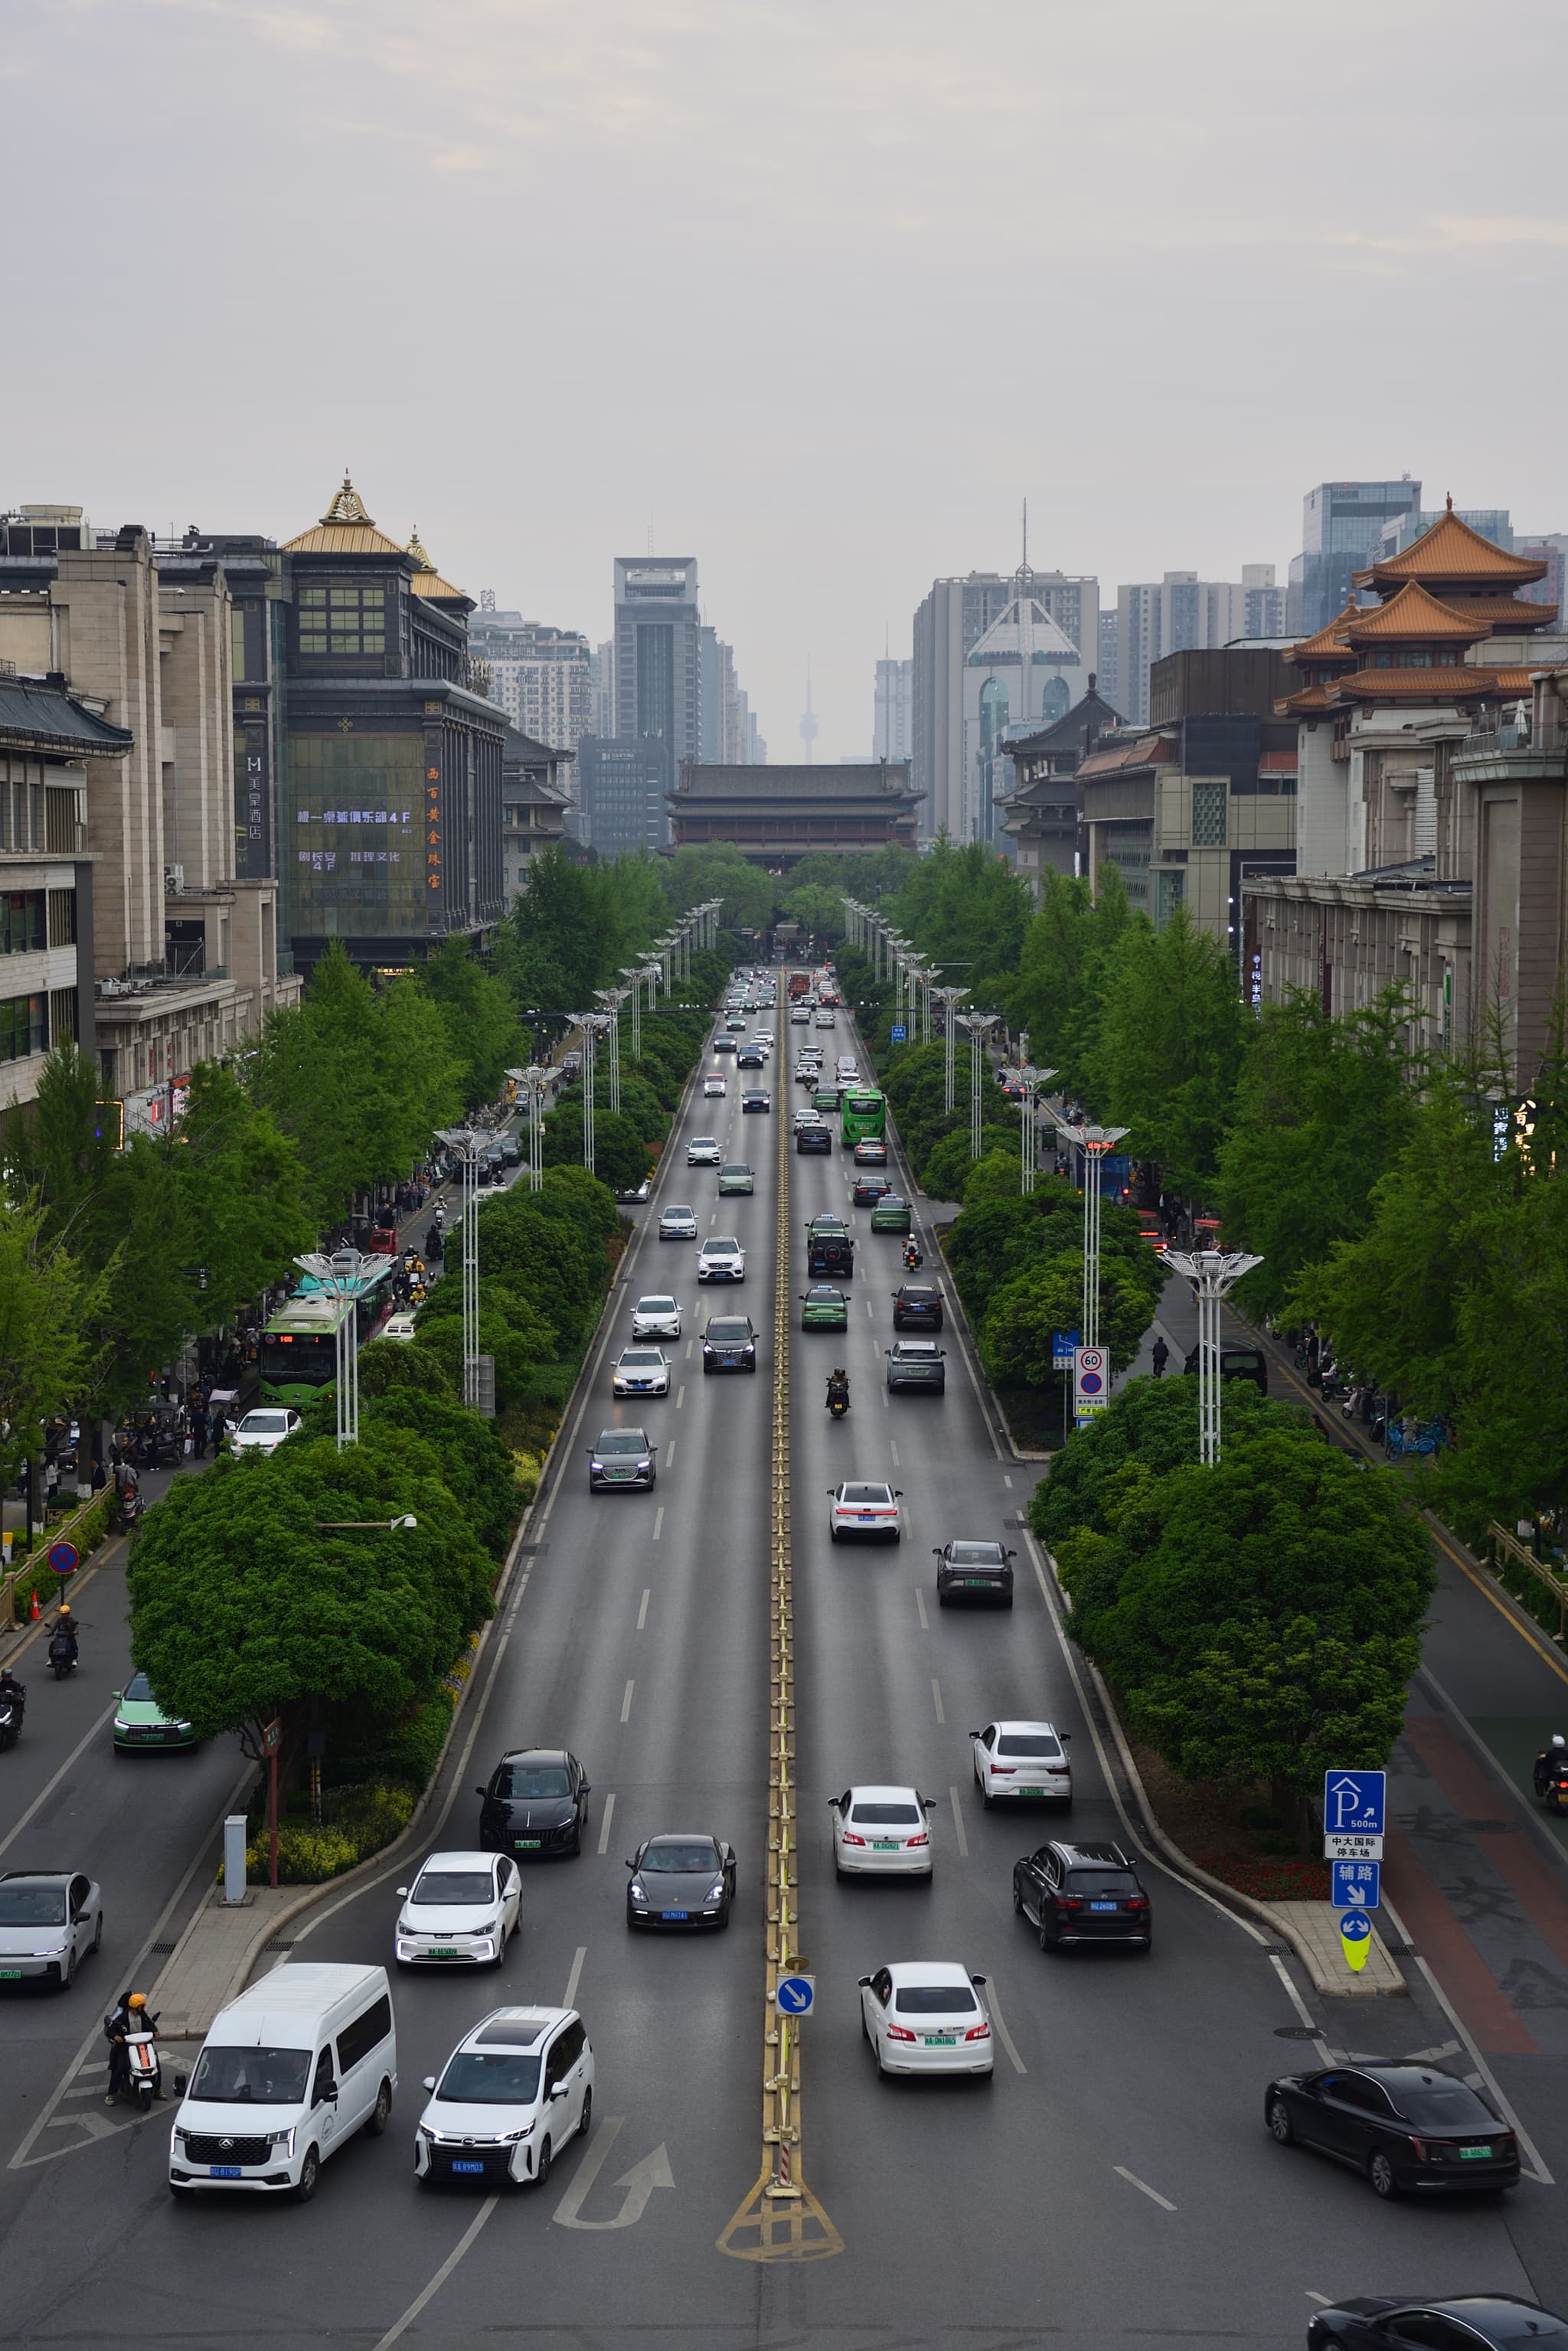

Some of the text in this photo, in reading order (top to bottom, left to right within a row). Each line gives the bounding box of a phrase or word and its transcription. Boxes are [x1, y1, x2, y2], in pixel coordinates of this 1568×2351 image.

[426, 768, 442, 889] 西百黄金珠宝
[1085, 1356, 1098, 1365] 60
[1334, 1791, 1360, 1828] P
[1351, 1820, 1378, 1829] 500m
[1332, 1837, 1376, 1847] 中大国际
[1337, 1847, 1370, 1857] 停车场
[1339, 1865, 1374, 1881] 辅路
